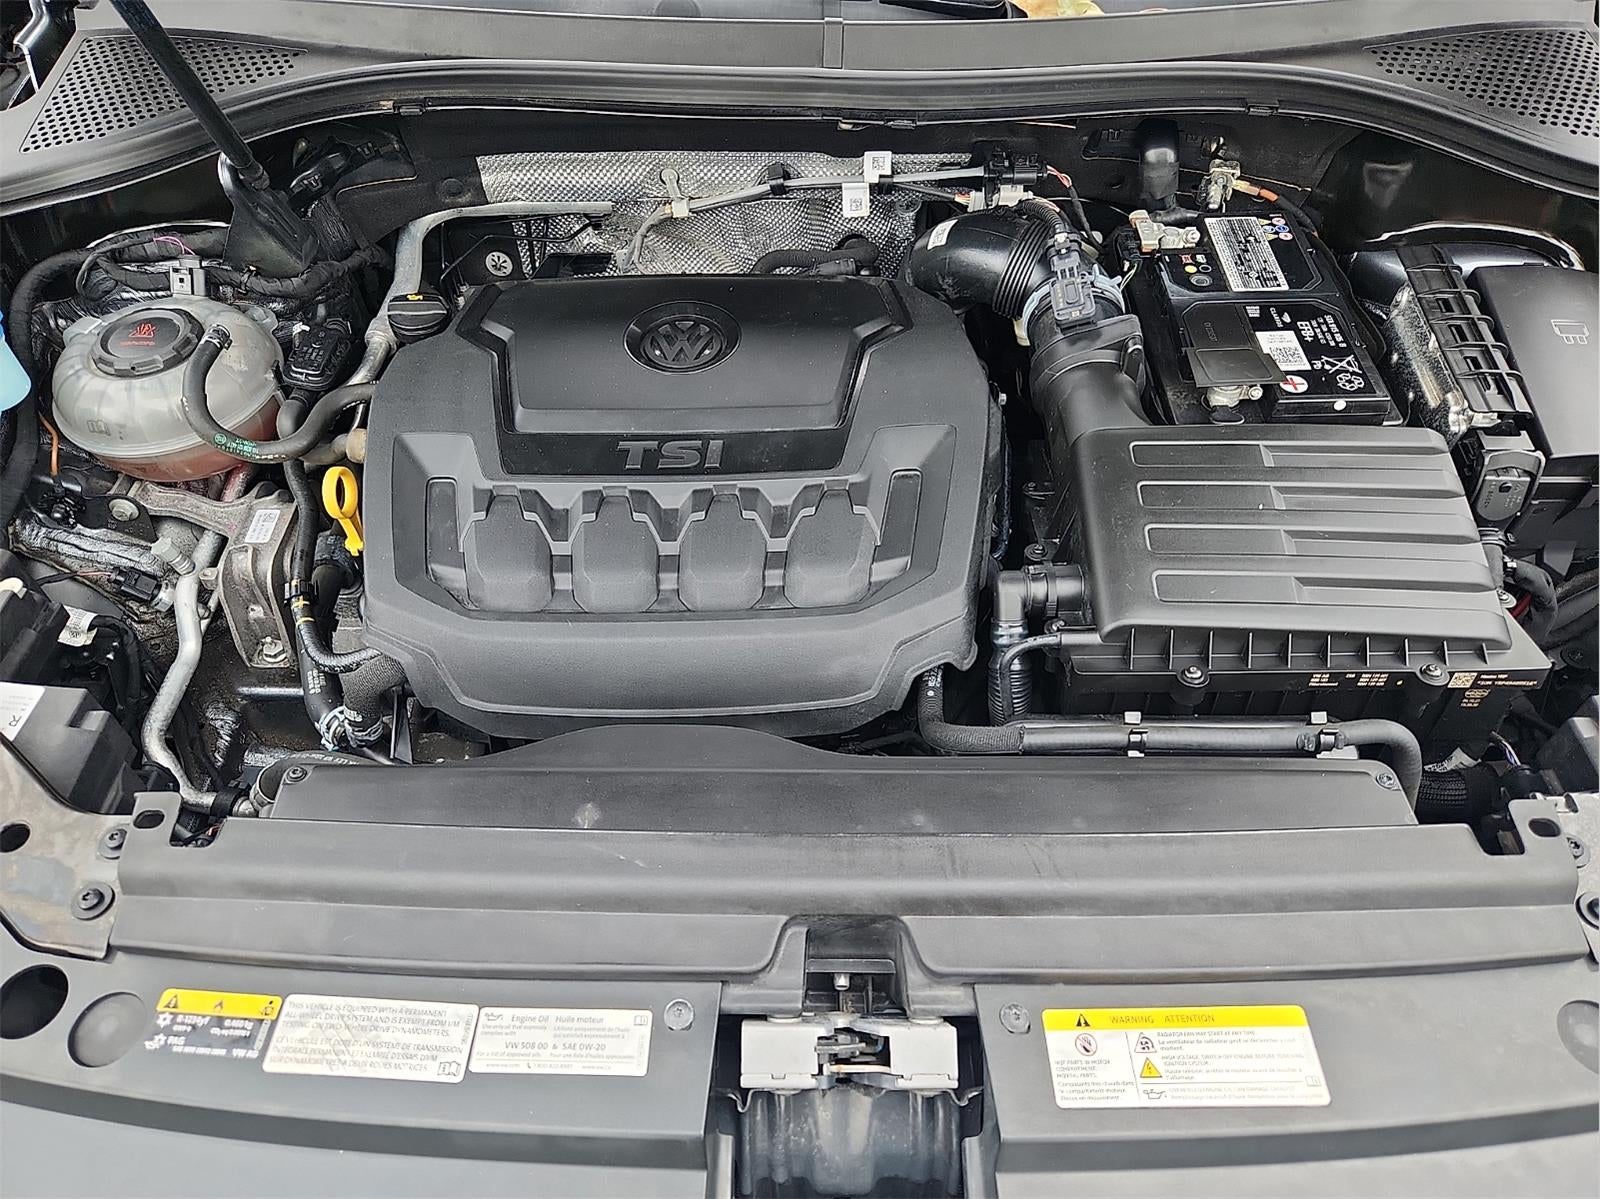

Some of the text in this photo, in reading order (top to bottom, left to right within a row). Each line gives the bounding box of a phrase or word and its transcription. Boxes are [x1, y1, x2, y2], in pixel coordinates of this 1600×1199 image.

[617, 439, 724, 469] TSI
[289, 1001, 304, 1009] THIS
[305, 1002, 333, 1011] VEHICLE
[342, 1004, 378, 1013] EQUIPPED
[405, 1008, 447, 1017] PERMANENT
[324, 1013, 345, 1021] DRIVE
[346, 1014, 373, 1023] SYSTEM
[374, 1015, 390, 1023] AND
[398, 1016, 426, 1025] EXEMPT
[426, 1018, 447, 1026] FROM
[511, 1015, 550, 1024] Engine Oil
[555, 1015, 576, 1023] Huile
[1110, 1014, 1216, 1024] WARNING ATTENTION
[281, 1020, 308, 1028] TESTING
[369, 1025, 391, 1033] DRIVE
[413, 1043, 464, 1054] TRANSMISSION
[504, 1041, 520, 1049] VW
[520, 1042, 537, 1050] 508
[537, 1042, 549, 1050] 00
[561, 1042, 577, 1050] SAE
